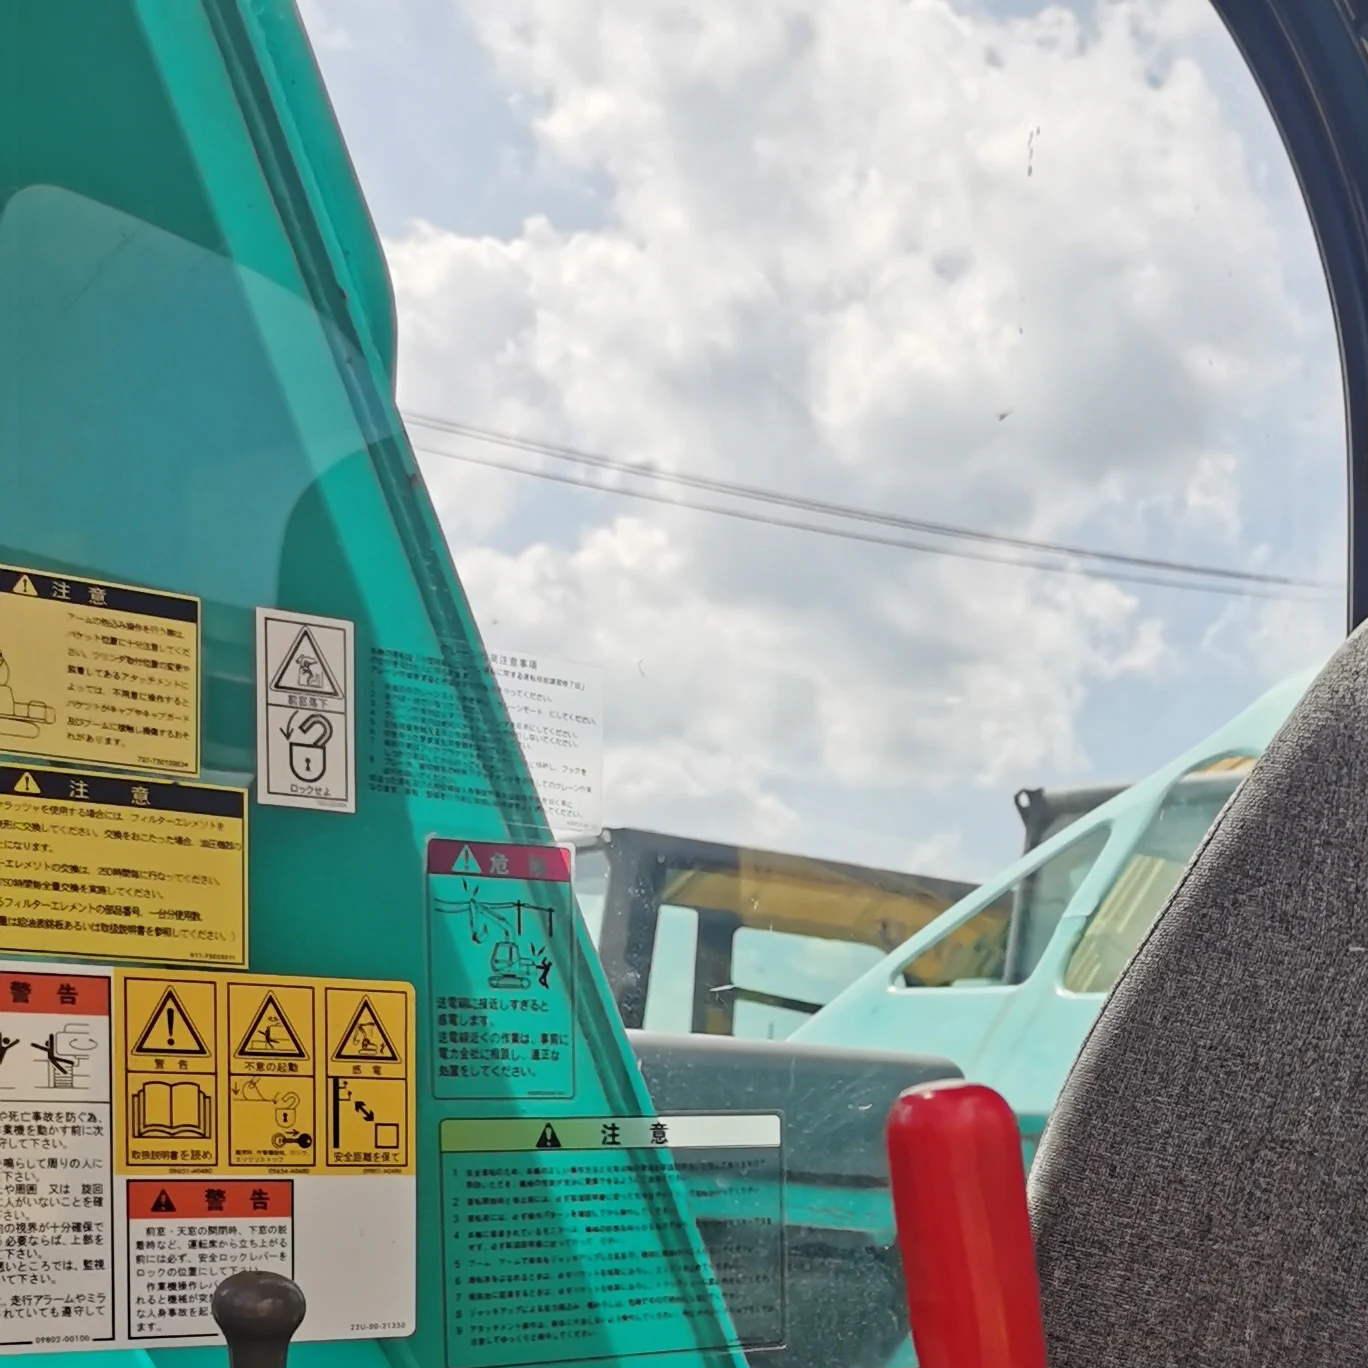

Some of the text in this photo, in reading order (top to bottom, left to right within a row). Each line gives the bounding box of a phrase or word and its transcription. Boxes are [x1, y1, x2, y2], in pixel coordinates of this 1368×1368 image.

[290, 784, 331, 796] ロックせよ
[244, 1062, 299, 1073] 不意の起動
[0, 1125, 104, 1137] 業機を動かす前に次
[131, 1150, 213, 1161] 取扱説明書を読め
[333, 1152, 400, 1163] 安全距離を保て
[0, 1158, 103, 1169] 鳴らして周りの人に
[0, 1184, 37, 1195] や周囲
[0, 1196, 103, 1208] 人がいないことを確
[0, 1210, 30, 1221] さい。
[0, 1234, 104, 1246] 必要ならば、上部を
[0, 1248, 42, 1260] 下さい。
[0, 1306, 105, 1319] れていても遵守して
[136, 1307, 214, 1319] な人身事故を起
[137, 1322, 162, 1332] ます。
